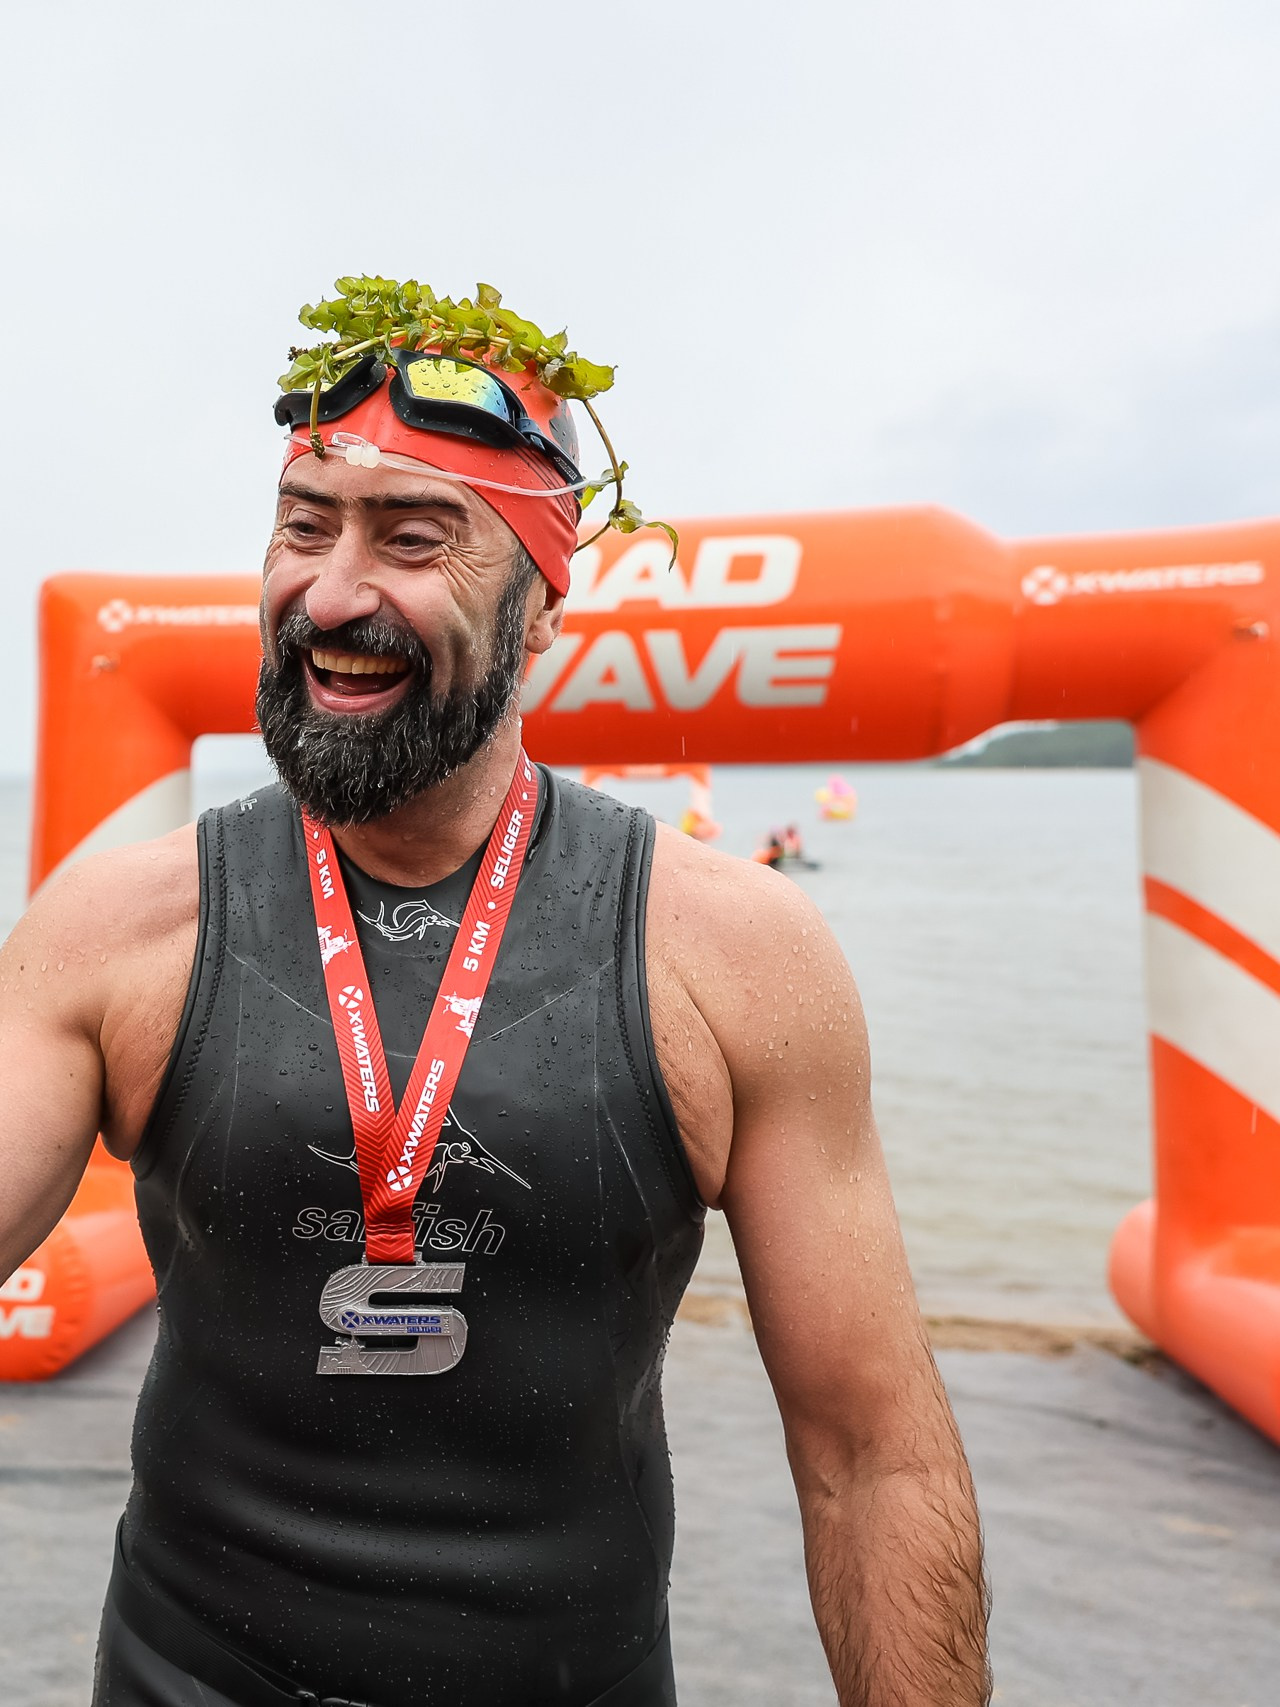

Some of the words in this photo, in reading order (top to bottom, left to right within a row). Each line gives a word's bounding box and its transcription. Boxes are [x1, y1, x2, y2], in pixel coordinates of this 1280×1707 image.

[316, 848, 327, 865] 5
[490, 809, 524, 890] SELIGER
[318, 866, 335, 900] KM
[468, 920, 491, 956] KM
[464, 957, 479, 972] 5
[292, 1201, 506, 1255] saish
